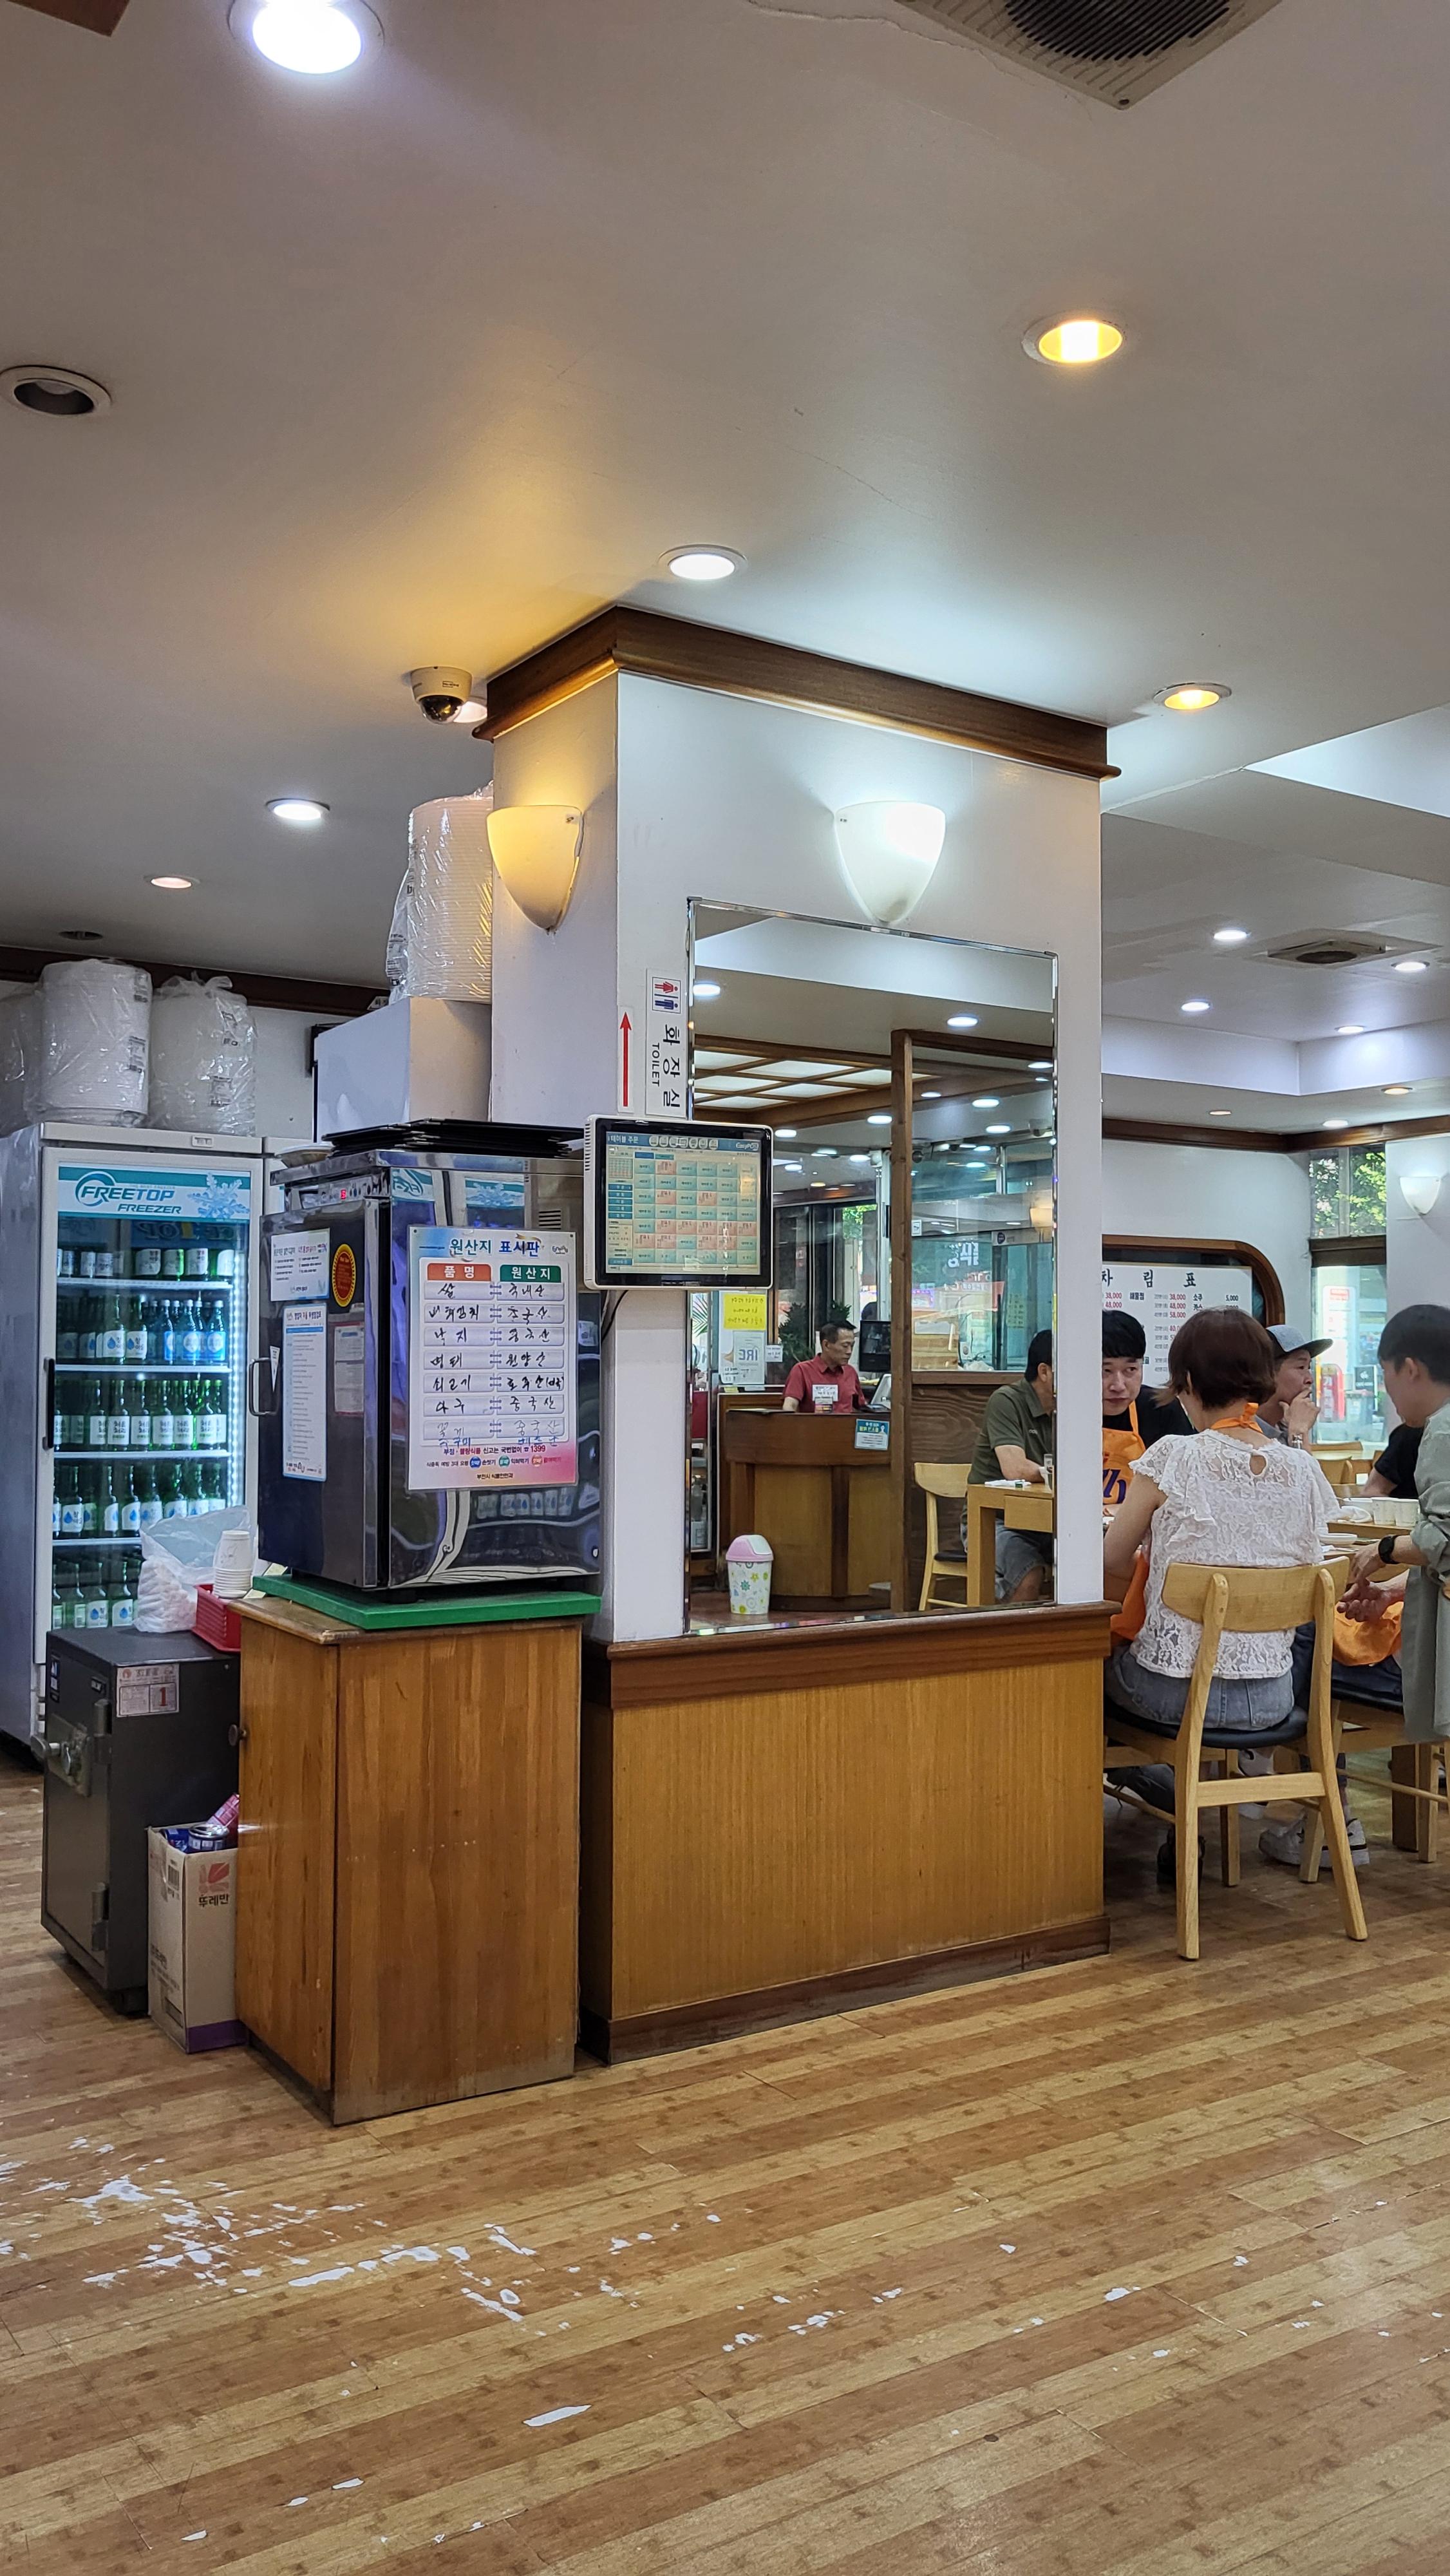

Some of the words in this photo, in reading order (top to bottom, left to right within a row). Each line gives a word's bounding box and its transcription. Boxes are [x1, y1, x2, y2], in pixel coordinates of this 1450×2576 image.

[652, 1041, 660, 1087] TOILET
[663, 1023, 681, 1108] 화장실
[80, 1186, 175, 1202] FREETOP
[117, 1203, 182, 1214] FREEZER
[450, 1238, 491, 1256] 원산지
[498, 1240, 540, 1257] 표시판
[511, 1267, 551, 1280] 원산지
[1192, 1293, 1203, 1302] 소주
[509, 1396, 557, 1412] 중국산
[514, 1419, 561, 1435] 중국산
